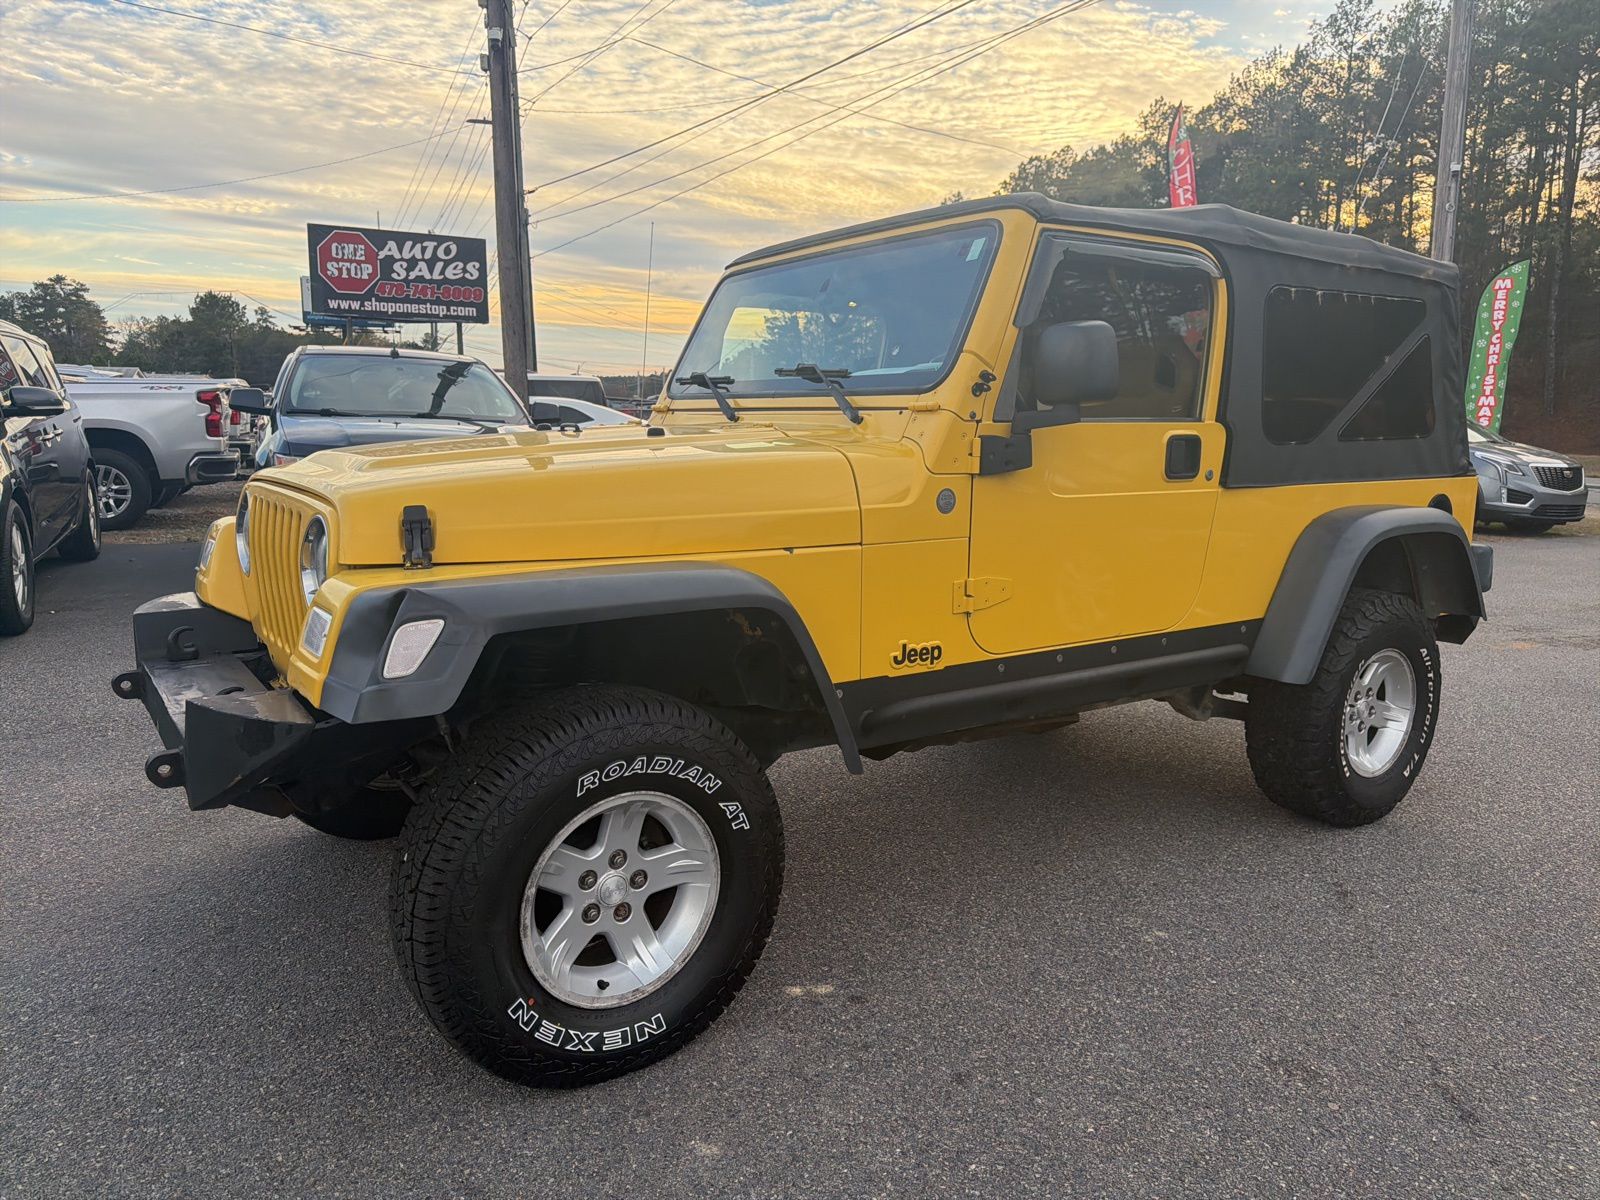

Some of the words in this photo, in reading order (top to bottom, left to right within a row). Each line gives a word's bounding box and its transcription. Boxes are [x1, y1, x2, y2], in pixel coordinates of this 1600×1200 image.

[331, 242, 366, 261] ONE
[377, 240, 458, 260] AUTO
[326, 261, 373, 280] STOP
[328, 297, 477, 317] www.shoponestop.com
[1491, 278, 1512, 331] MERRY
[1478, 333, 1501, 427] CHRISTMAS
[891, 642, 943, 667] Jeep
[576, 756, 722, 798] ROADIAN
[718, 801, 750, 831] AT
[507, 997, 667, 1052] NEXEN
